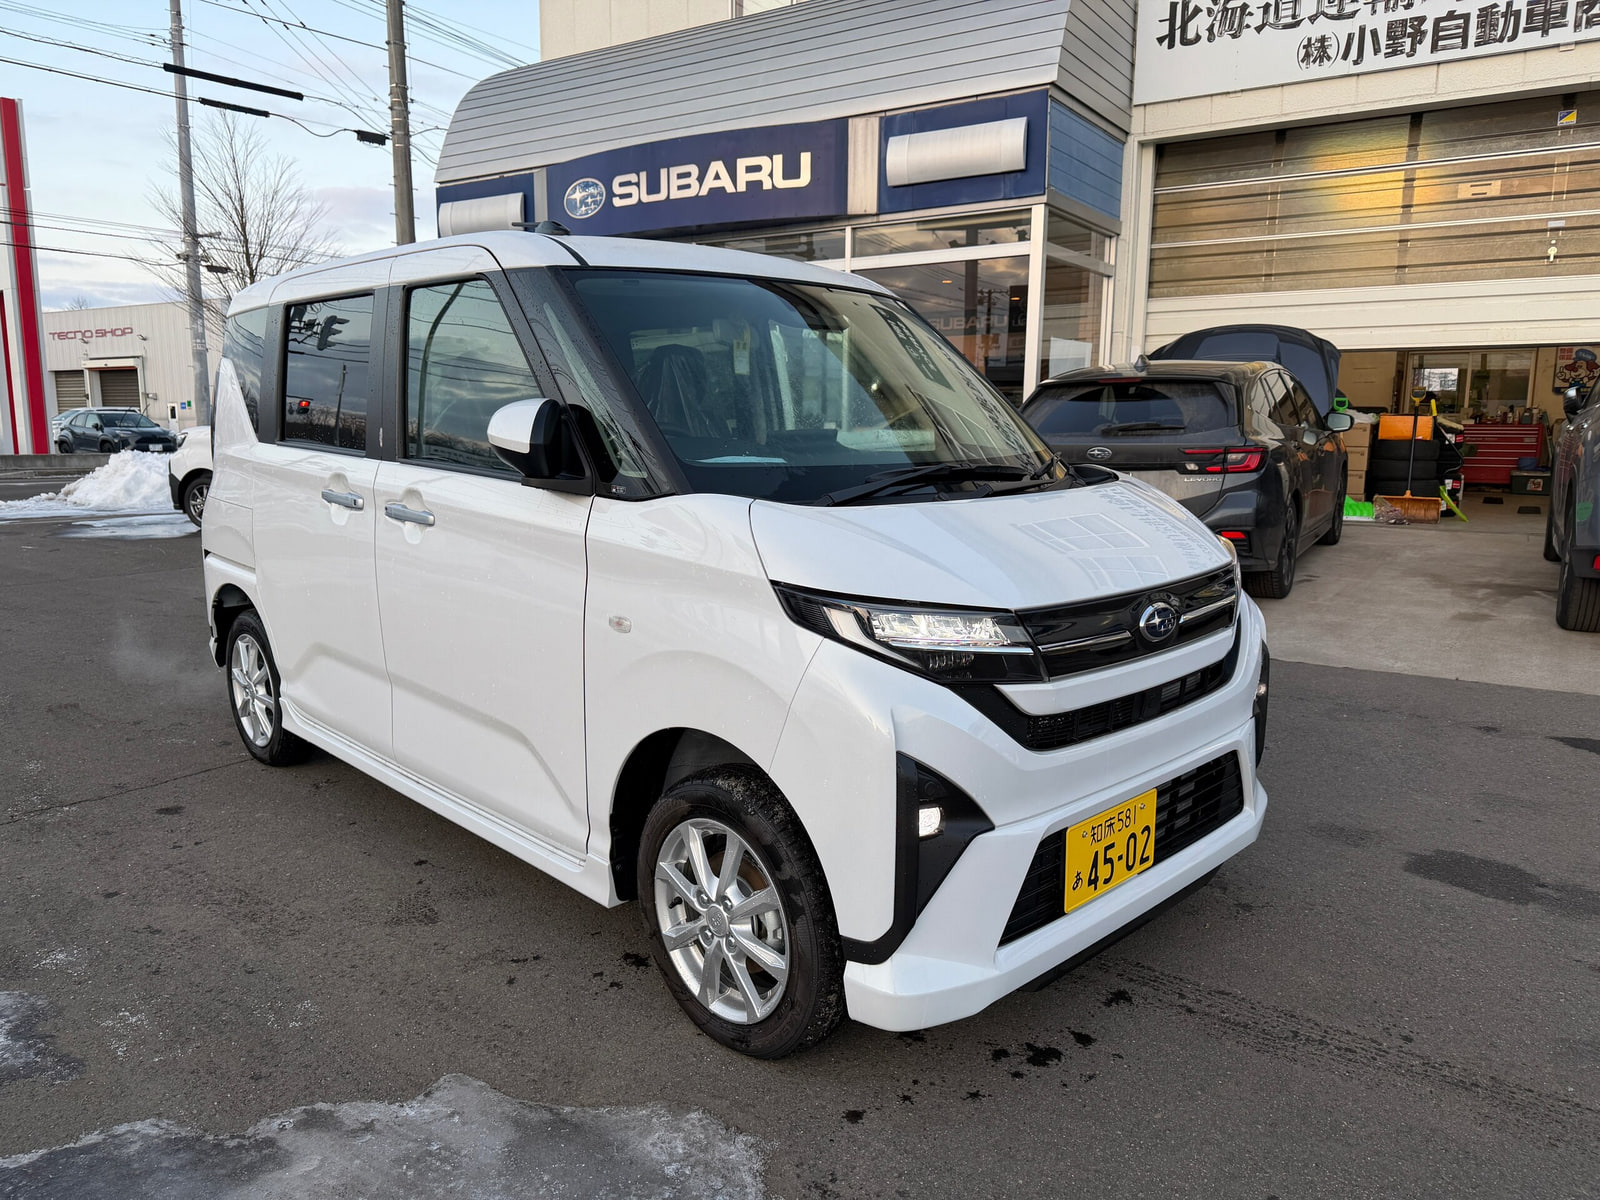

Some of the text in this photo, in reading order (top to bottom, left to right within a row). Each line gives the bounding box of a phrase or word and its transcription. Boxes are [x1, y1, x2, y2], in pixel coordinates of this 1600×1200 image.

[612, 151, 812, 207] SUBARU
[49, 327, 133, 341] TECNO SHOP
[1072, 825, 1151, 891] あ 45-02
